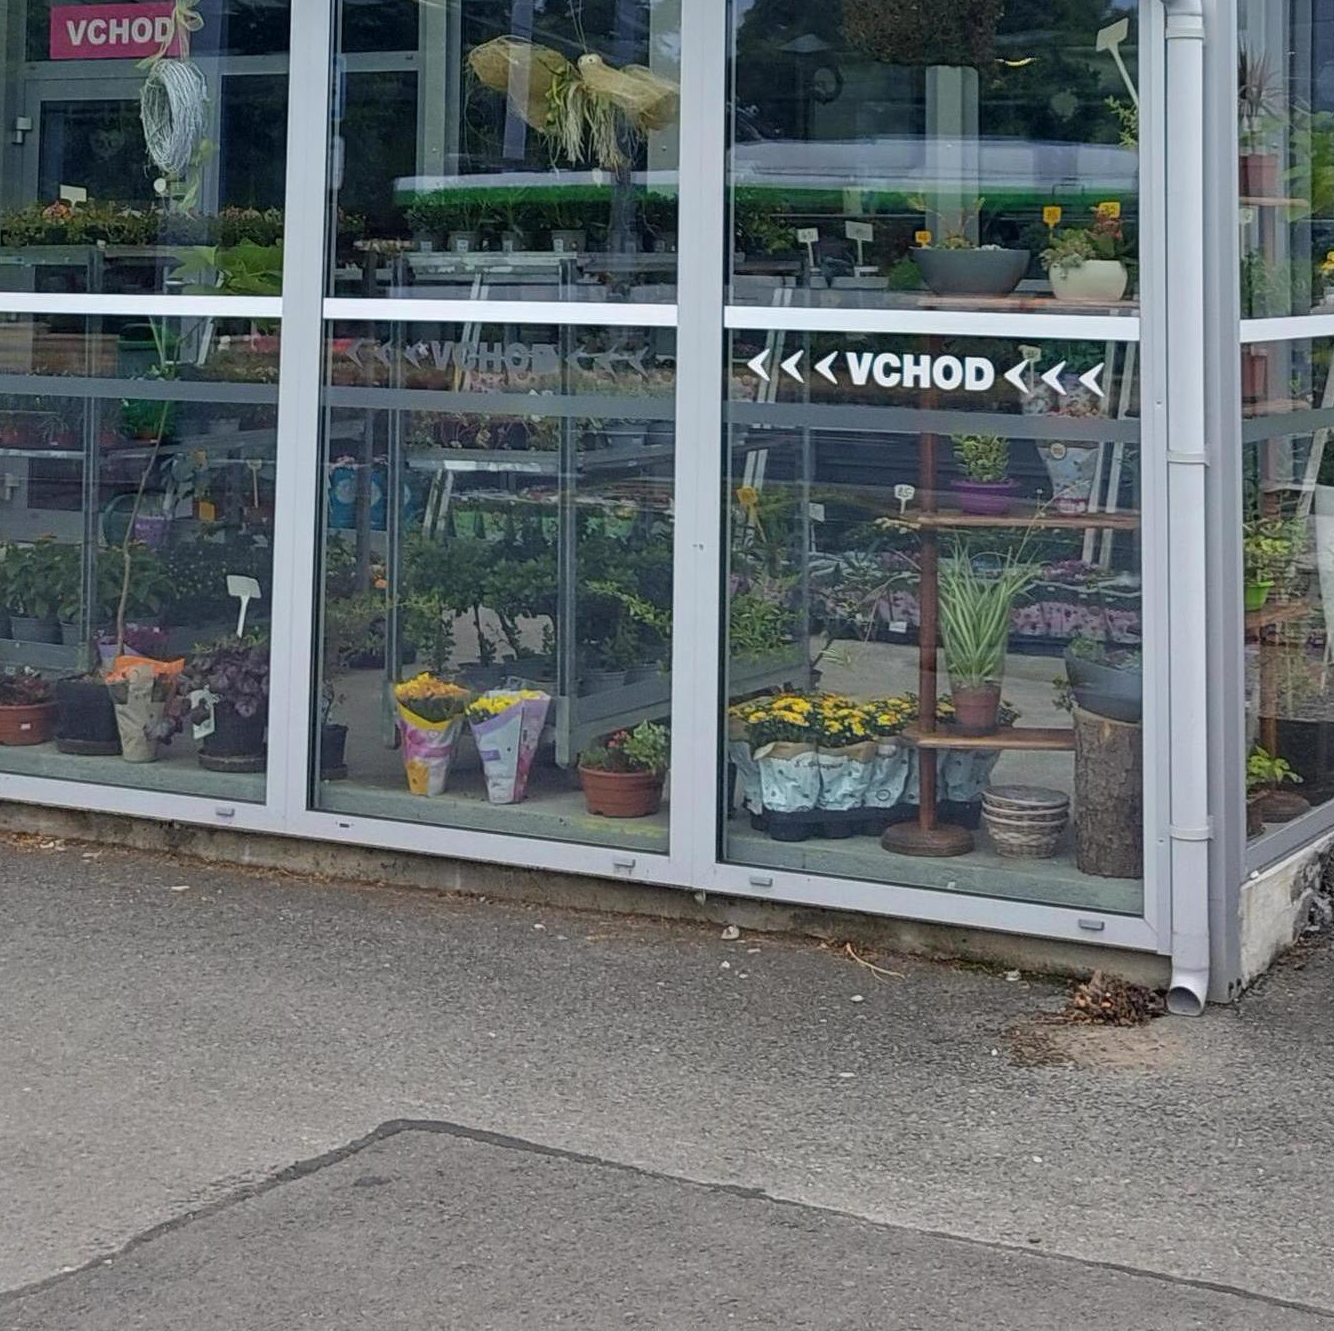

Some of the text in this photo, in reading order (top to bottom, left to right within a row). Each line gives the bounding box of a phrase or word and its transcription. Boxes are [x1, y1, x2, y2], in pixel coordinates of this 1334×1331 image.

[67, 16, 174, 45] VCHOD
[432, 341, 560, 374] VCHOD
[846, 352, 995, 391] VCHOD
